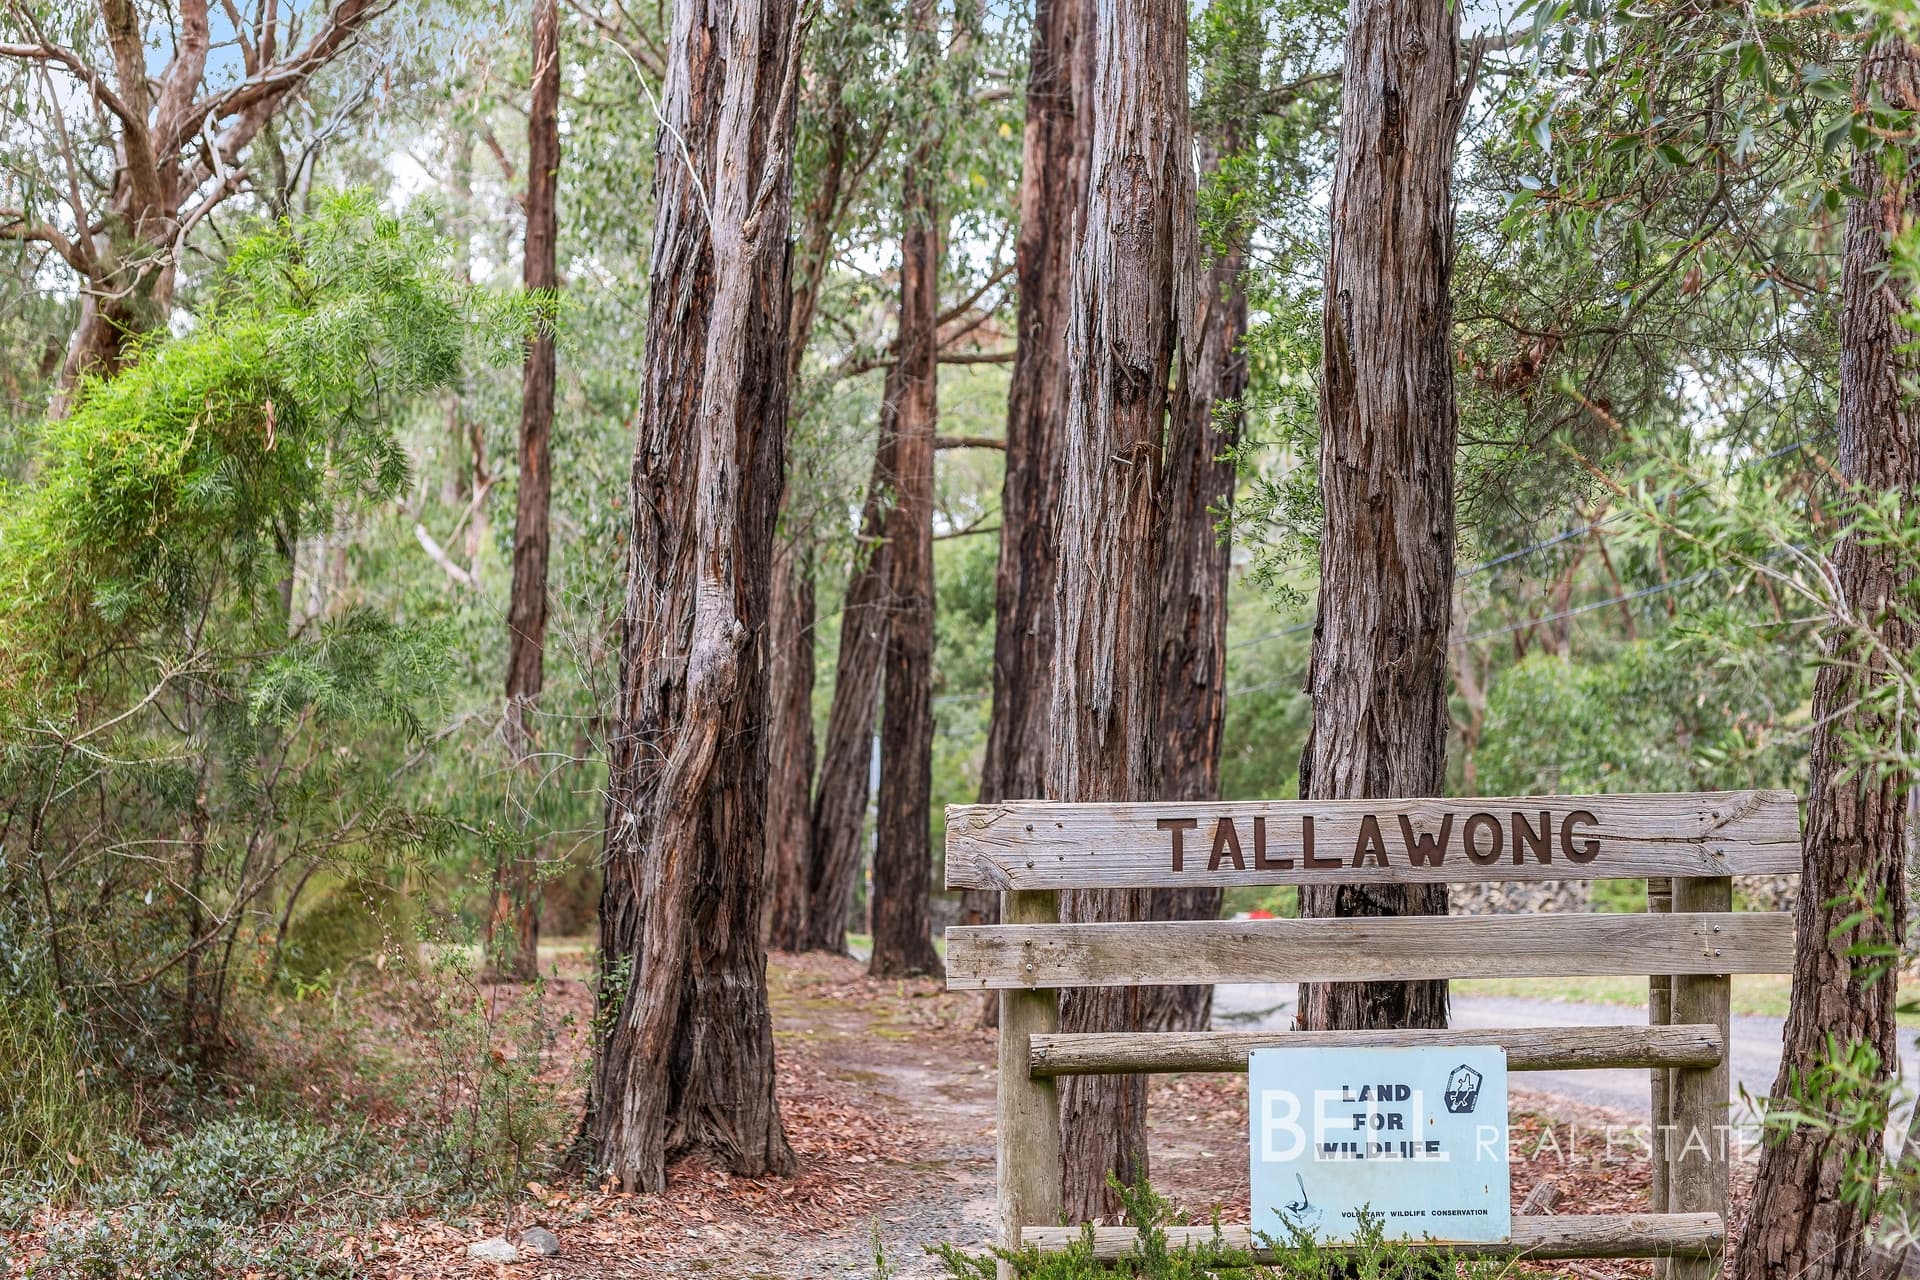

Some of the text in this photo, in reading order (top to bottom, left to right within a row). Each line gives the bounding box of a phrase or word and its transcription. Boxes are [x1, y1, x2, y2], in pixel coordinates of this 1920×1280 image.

[1157, 810, 1601, 872] TALLAWONG
[1342, 1084, 1411, 1102] LAND
[1352, 1113, 1404, 1130] FOR
[1315, 1141, 1440, 1160] WILDLIFE
[1431, 1209, 1488, 1217] CONSERVATION
